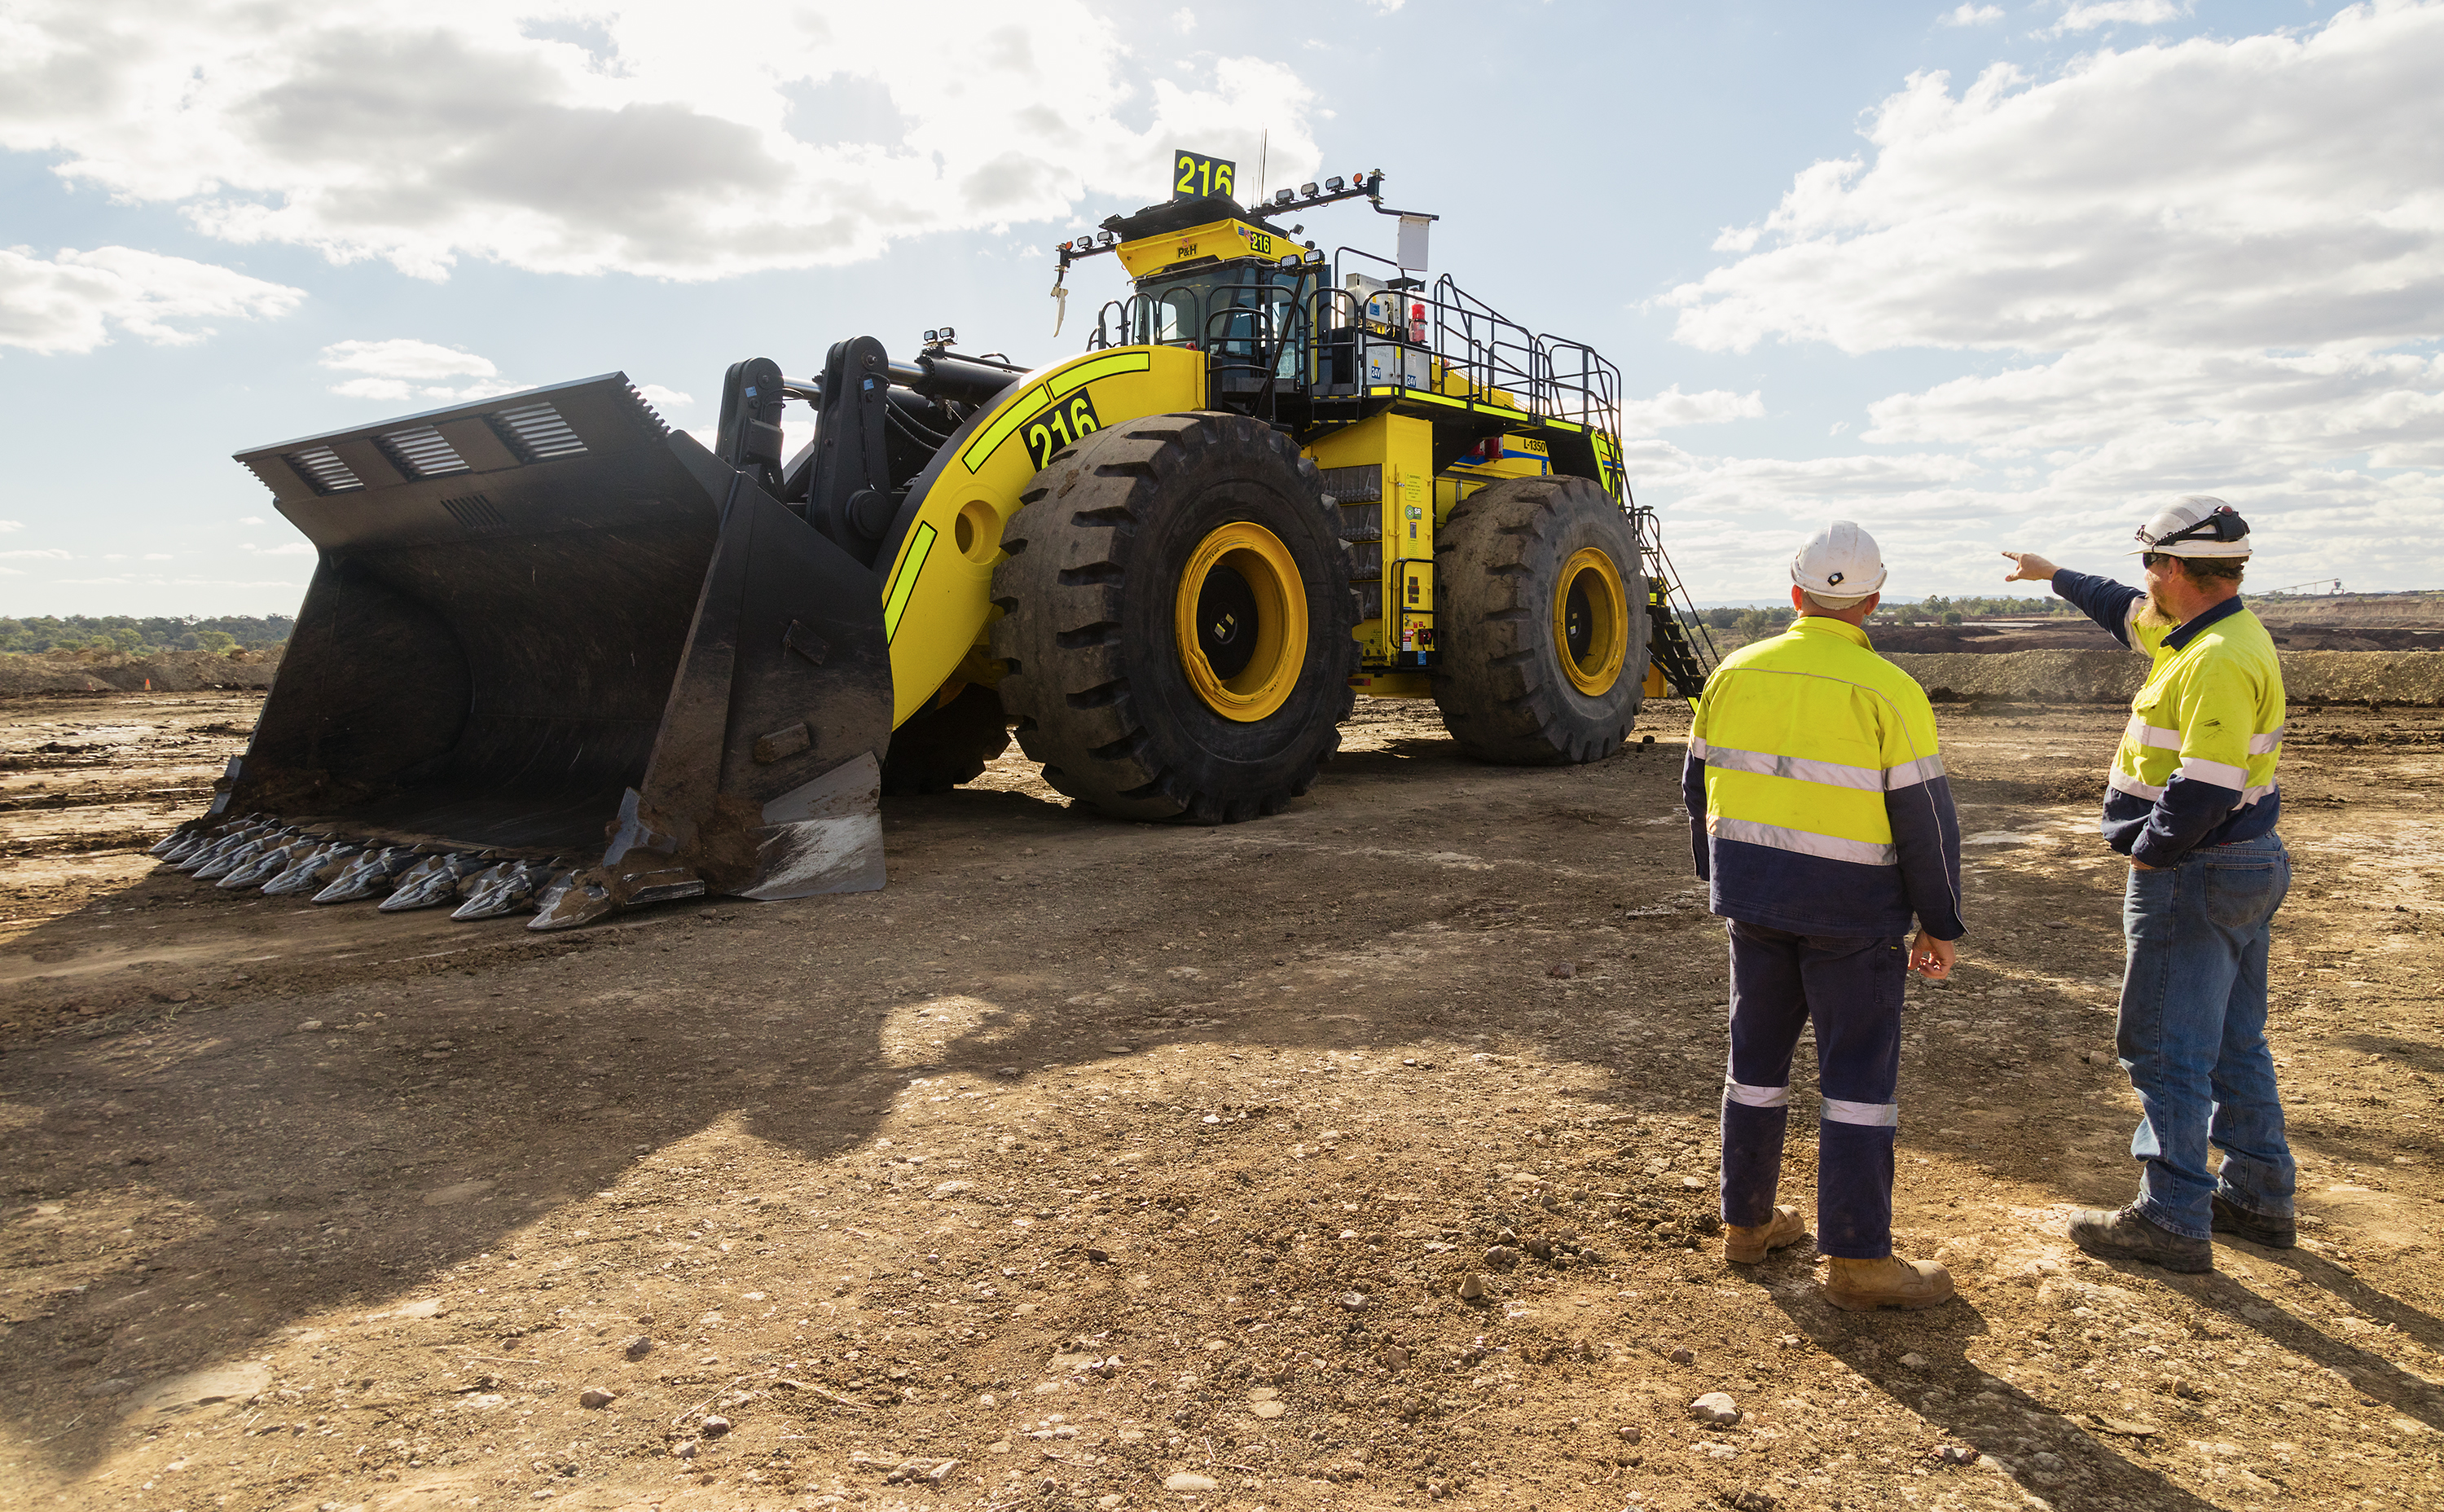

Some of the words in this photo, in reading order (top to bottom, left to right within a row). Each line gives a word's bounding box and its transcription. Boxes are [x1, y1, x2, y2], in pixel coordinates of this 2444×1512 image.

[1176, 156, 1233, 197] 216
[1251, 233, 1270, 253] 216
[1178, 244, 1197, 258] P&H
[1371, 367, 1381, 378] 24V
[1408, 376, 1417, 386] 24V
[1029, 397, 1097, 470] 216
[1523, 438, 1545, 453] L-1350
